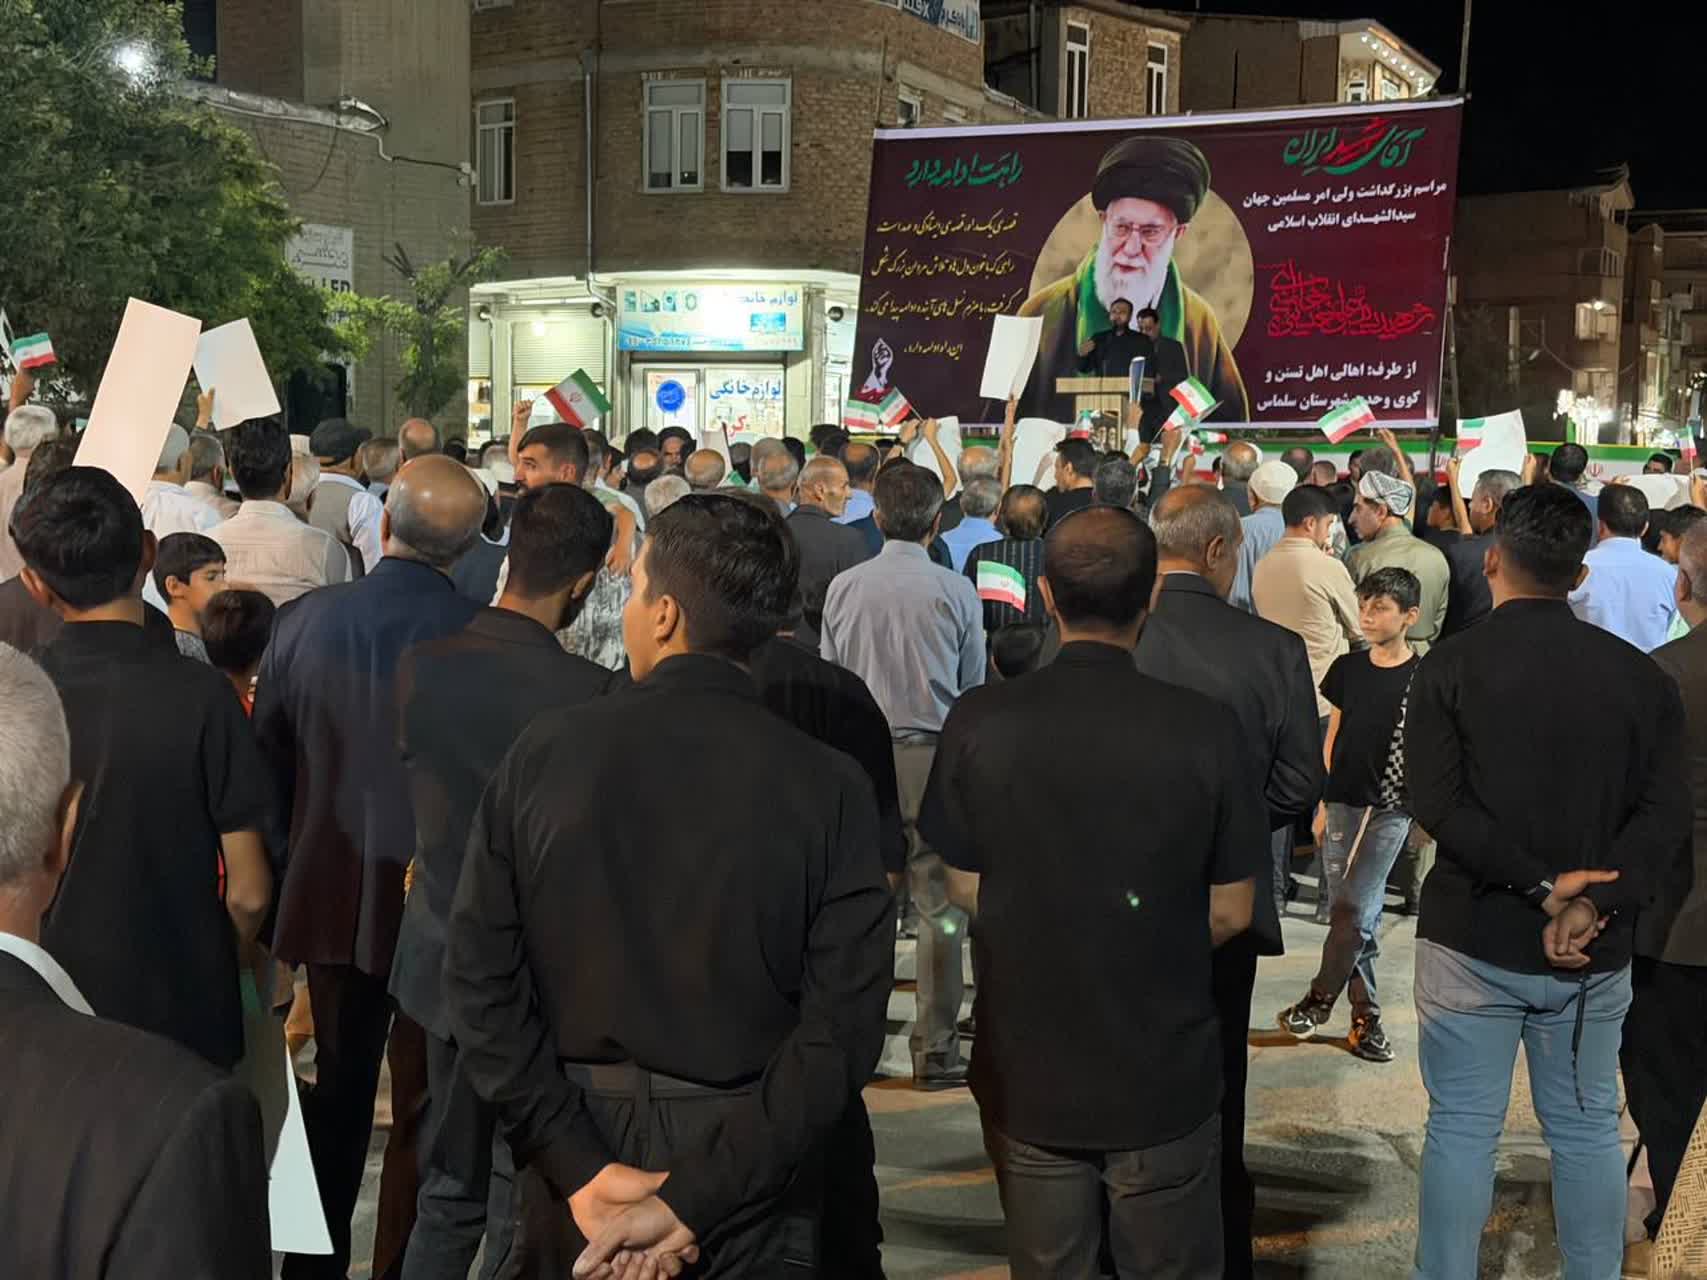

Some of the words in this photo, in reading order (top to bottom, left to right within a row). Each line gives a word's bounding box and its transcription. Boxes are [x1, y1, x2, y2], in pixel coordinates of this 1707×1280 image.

[1283, 127, 1338, 177] ایران
[1325, 126, 1426, 176] آقای
[1272, 188, 1311, 206] مسلمین
[1312, 187, 1330, 205] امر
[1332, 186, 1354, 202] ولی
[1356, 183, 1412, 201] بزرگداشت
[1412, 179, 1447, 197] مراسم
[1242, 191, 1271, 208] جهان
[1267, 214, 1306, 232] اسلامی
[1306, 212, 1340, 230] انقلاب
[871, 245, 889, 277] شکل
[887, 248, 908, 279] بزرگ
[904, 260, 928, 277] مردان
[768, 289, 798, 306] لوازم
[1264, 368, 1273, 383] و
[1273, 366, 1304, 383] تسنن
[1305, 364, 1329, 382] اهل
[1330, 362, 1365, 381] اهالی
[1367, 362, 1402, 381] طرف:
[1405, 360, 1417, 379] از
[709, 379, 751, 400] خانگی
[751, 379, 782, 402] لوازم
[1256, 394, 1297, 412] سلماس
[1299, 391, 1352, 411] شهرستان
[1392, 389, 1421, 410] کوی
